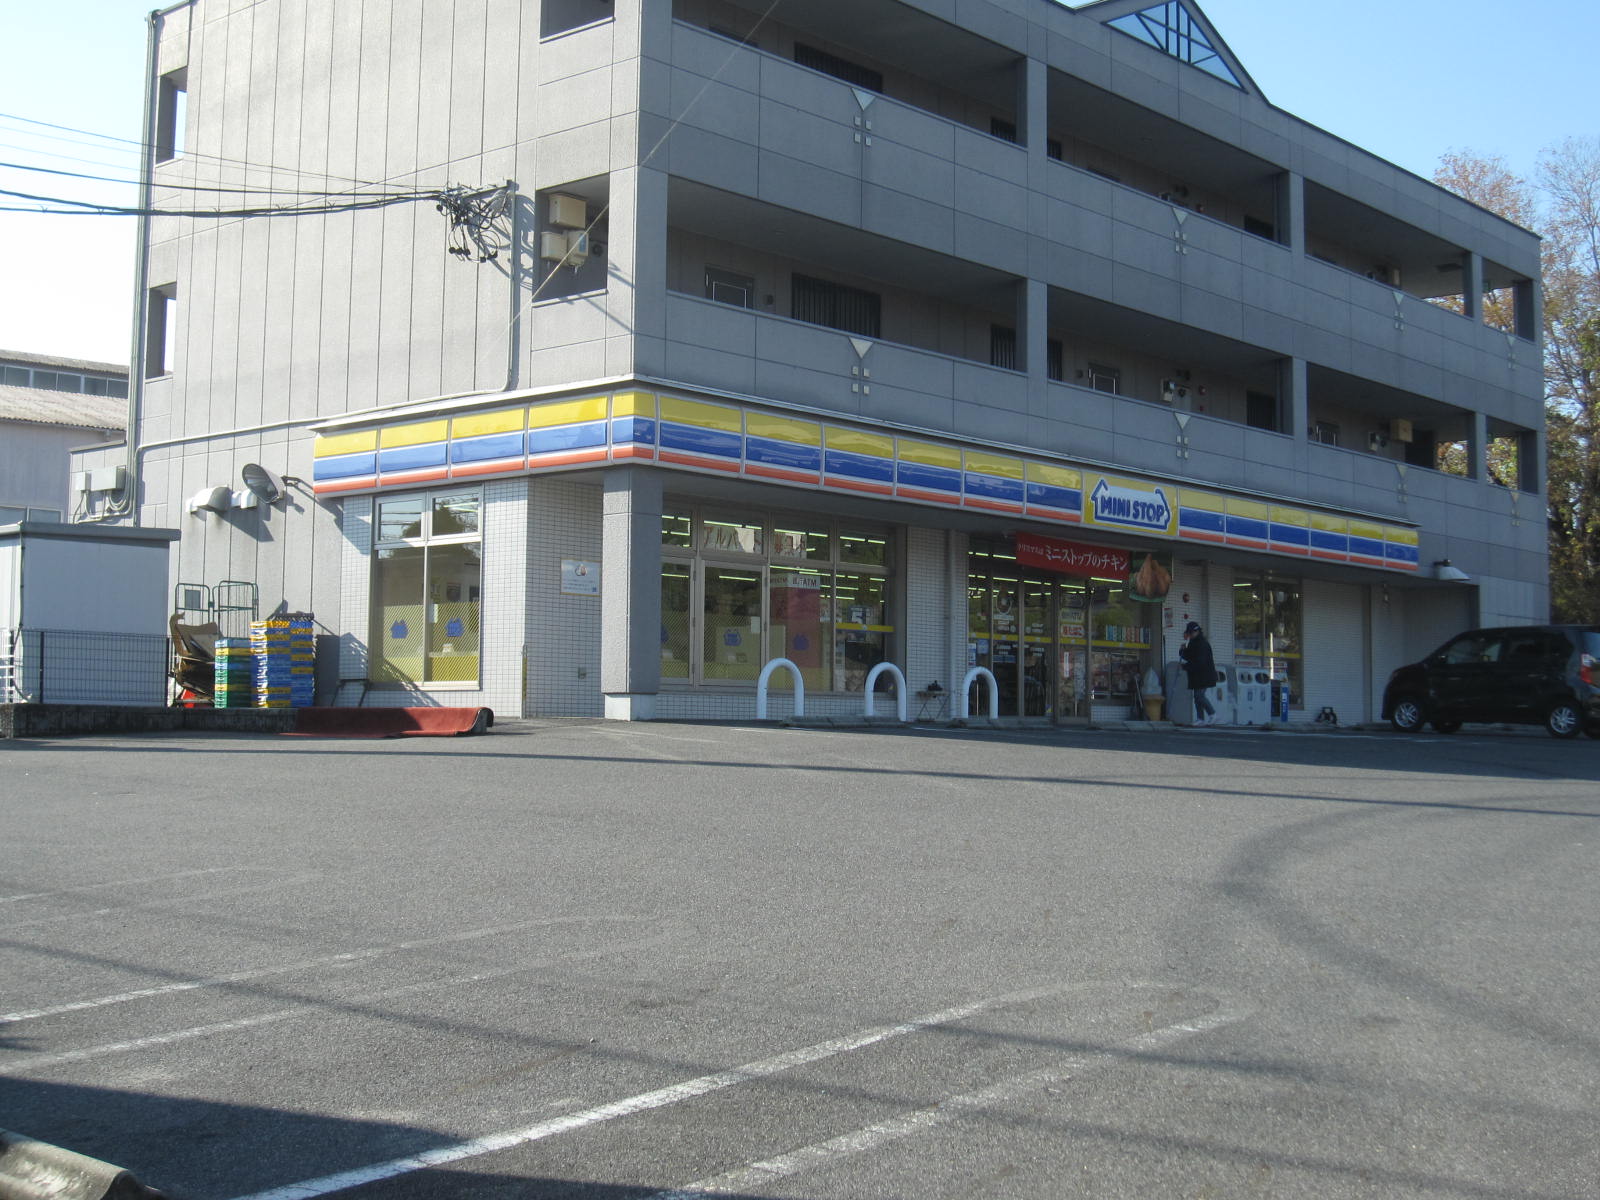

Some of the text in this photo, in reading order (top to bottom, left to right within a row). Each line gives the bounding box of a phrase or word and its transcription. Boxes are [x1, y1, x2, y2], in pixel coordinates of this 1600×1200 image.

[1101, 495, 1165, 522] MINI STOP
[1045, 544, 1128, 571] ミニストップのチキン
